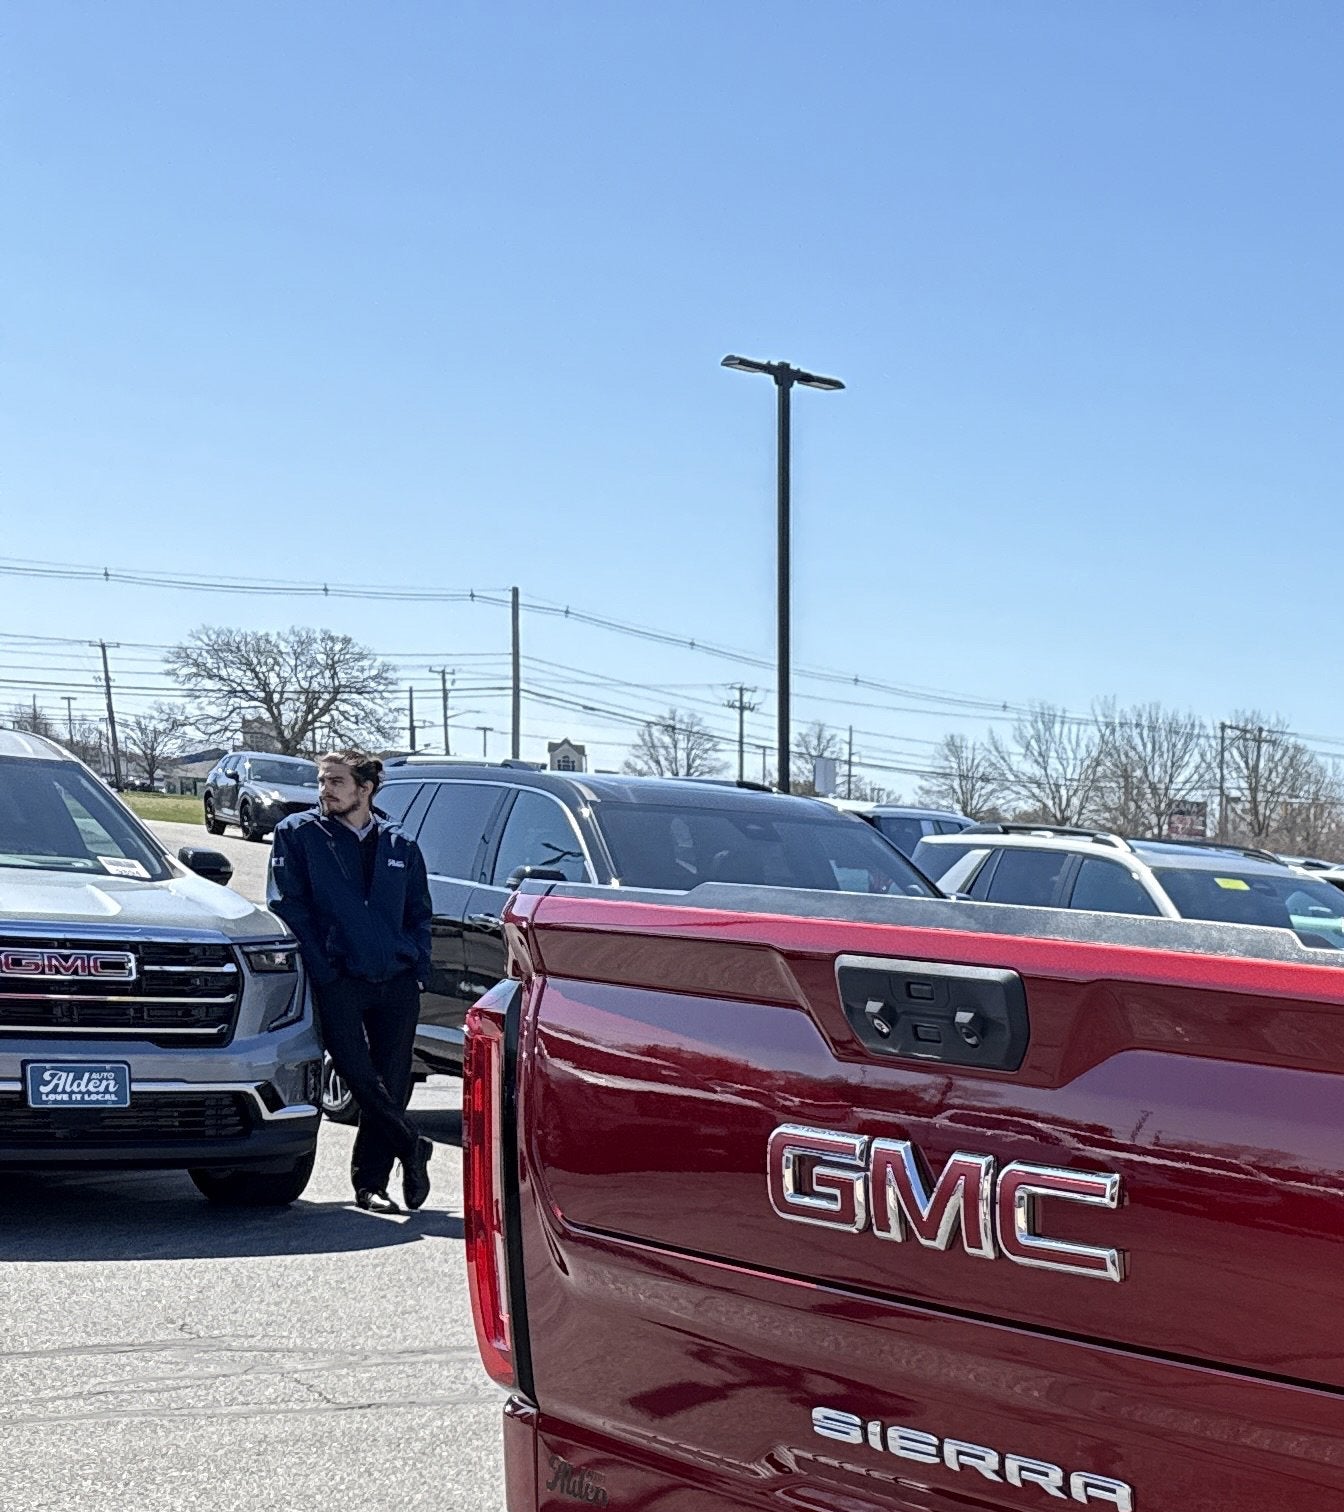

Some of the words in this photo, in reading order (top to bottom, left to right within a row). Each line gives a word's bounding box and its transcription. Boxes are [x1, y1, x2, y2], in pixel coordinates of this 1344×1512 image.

[2, 952, 130, 976] GMC
[39, 1070, 119, 1093] Alden
[766, 1122, 1123, 1283] GMC
[811, 1406, 1134, 1512] SIERRA
